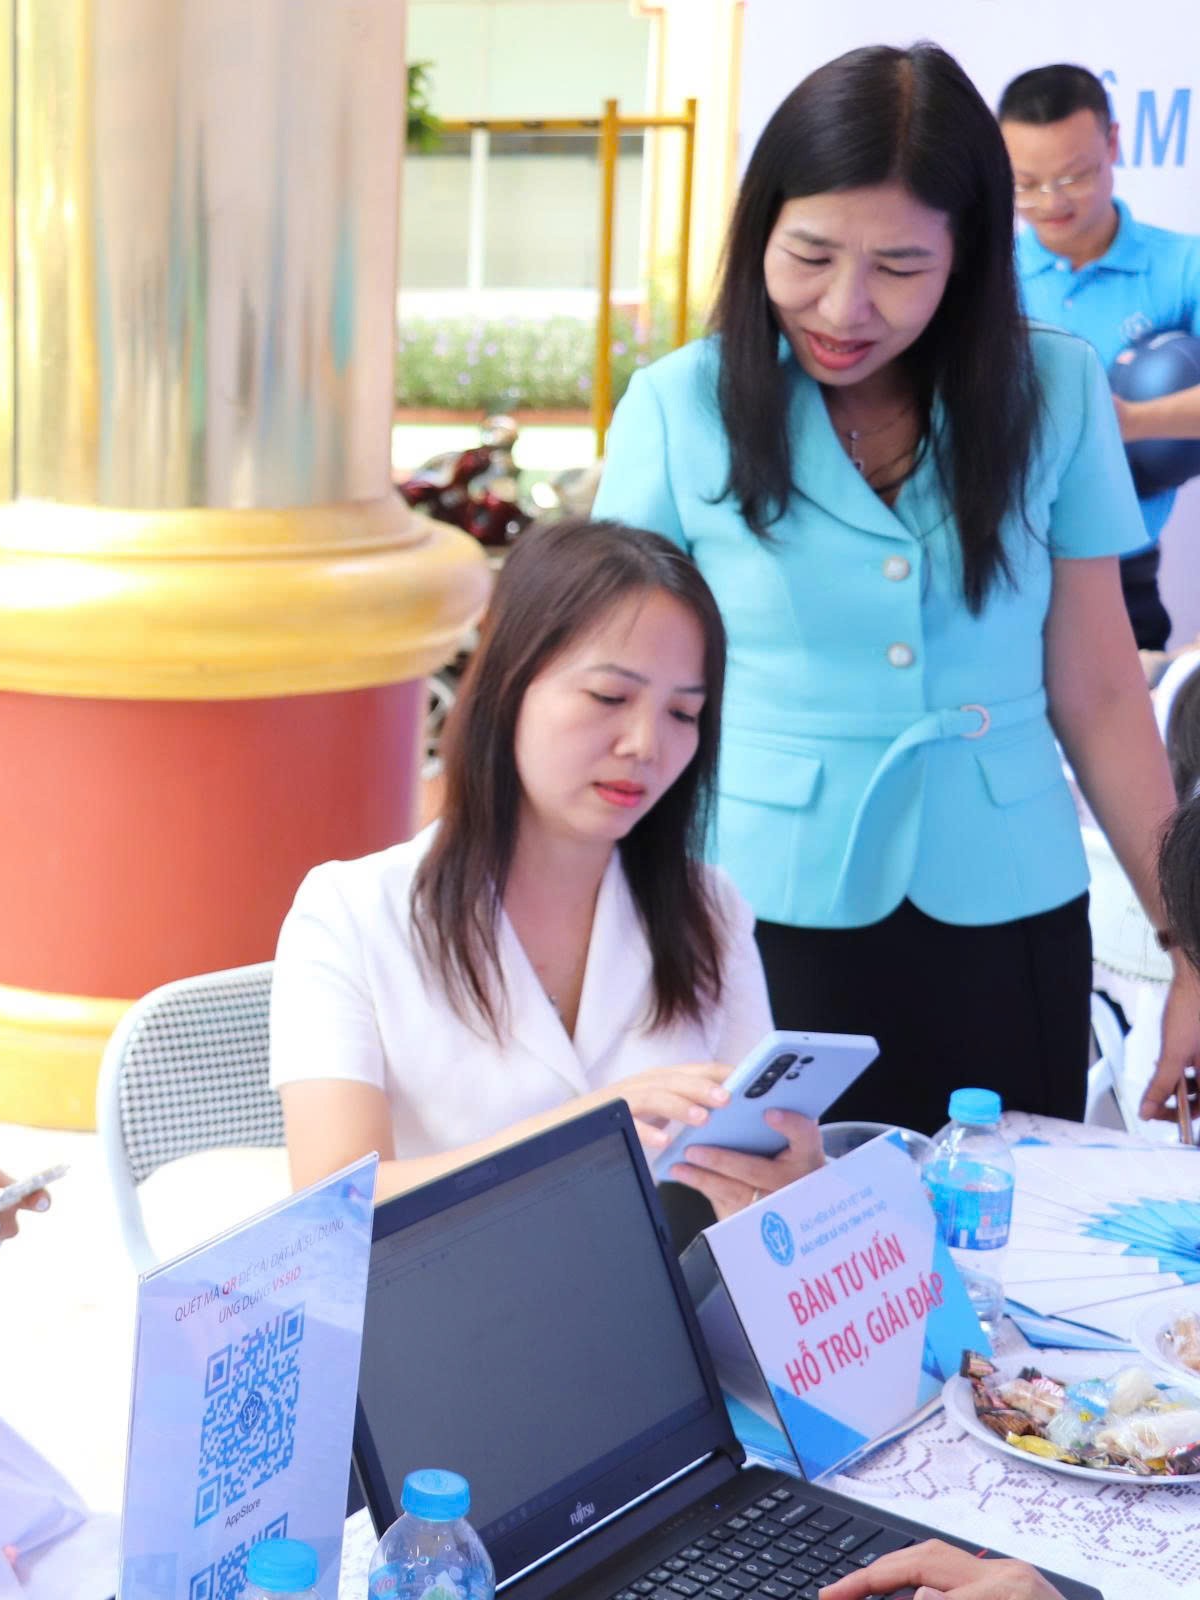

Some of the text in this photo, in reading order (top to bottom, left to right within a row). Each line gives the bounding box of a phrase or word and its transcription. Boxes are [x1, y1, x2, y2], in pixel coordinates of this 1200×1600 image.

[222, 1275, 238, 1295] QR
[788, 1230, 906, 1326] BÀN TƯ VẤN
[785, 1272, 944, 1396] HỖ TRỢ, GIẢI ĐÁP
[224, 1498, 261, 1529] AppStore
[569, 1502, 595, 1525] FUJITSU
